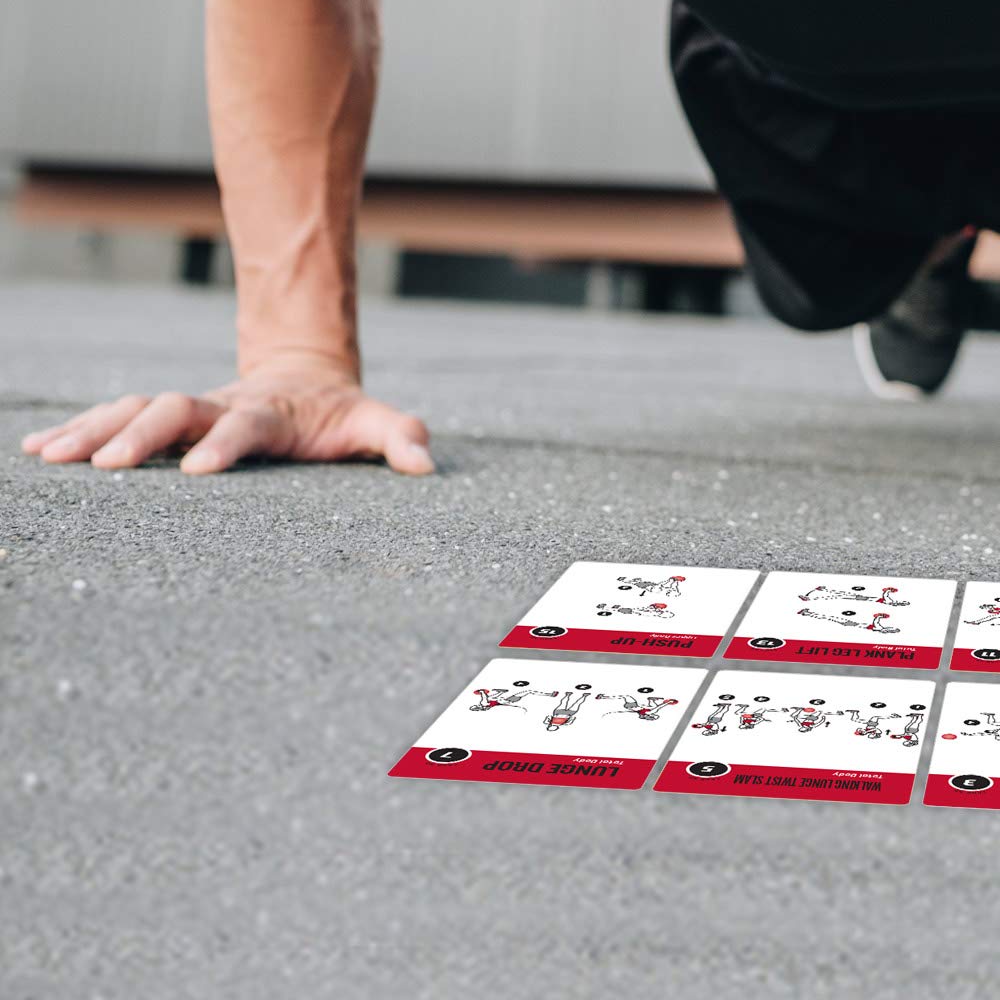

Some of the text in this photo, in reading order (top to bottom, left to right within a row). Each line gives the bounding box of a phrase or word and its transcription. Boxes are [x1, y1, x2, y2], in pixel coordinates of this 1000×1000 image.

[610, 637, 693, 648] PUSH-UP
[795, 646, 915, 660] PLANK LEG LIFT
[483, 761, 619, 777] LUNGE DROP
[700, 765, 716, 773] 5
[733, 774, 763, 785] SLAM
[764, 776, 797, 787] TWIST
[801, 778, 834, 788] LUNGE
[834, 780, 882, 791] WALKING
